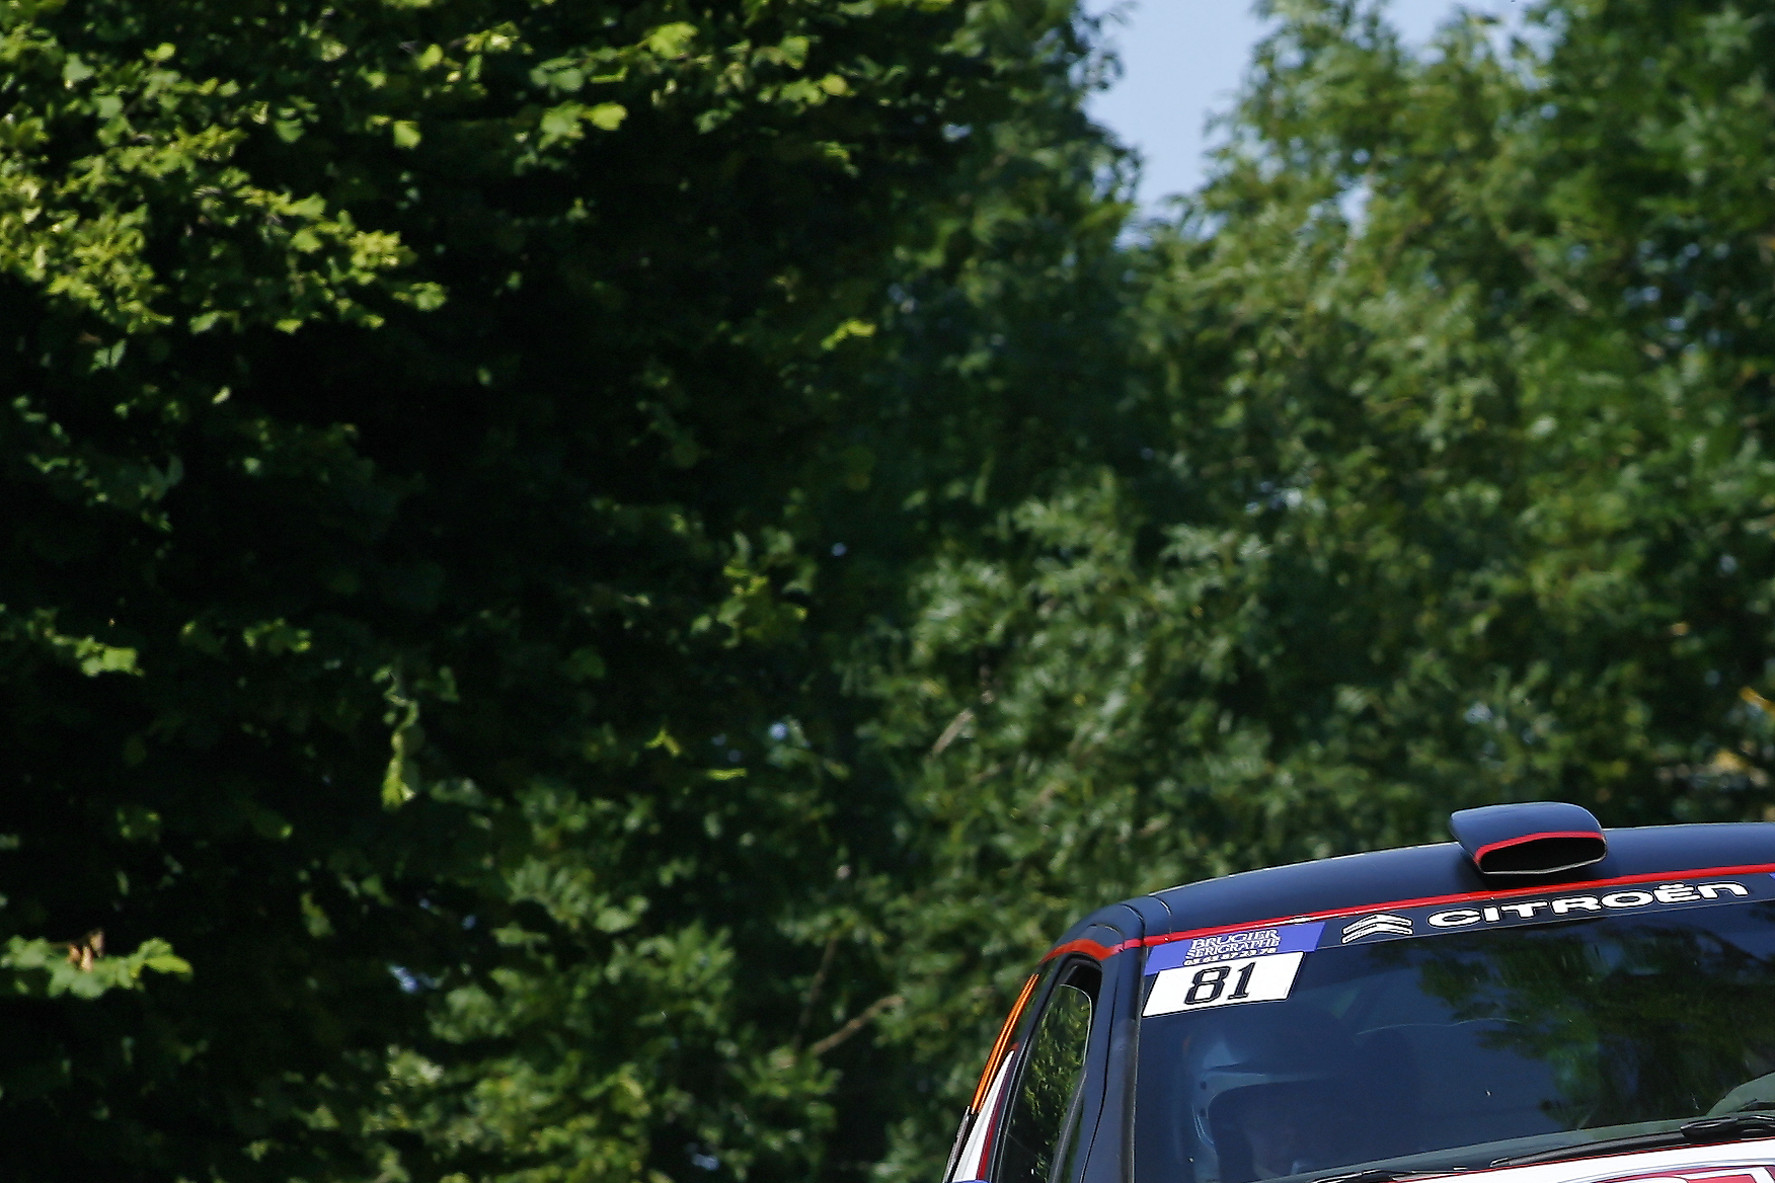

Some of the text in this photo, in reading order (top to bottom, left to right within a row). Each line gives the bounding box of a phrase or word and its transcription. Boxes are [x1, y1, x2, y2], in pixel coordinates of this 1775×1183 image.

[1428, 882, 1750, 929] CITROËN
[1191, 929, 1278, 950] BRUGIER
[1184, 962, 1256, 1005] 81
